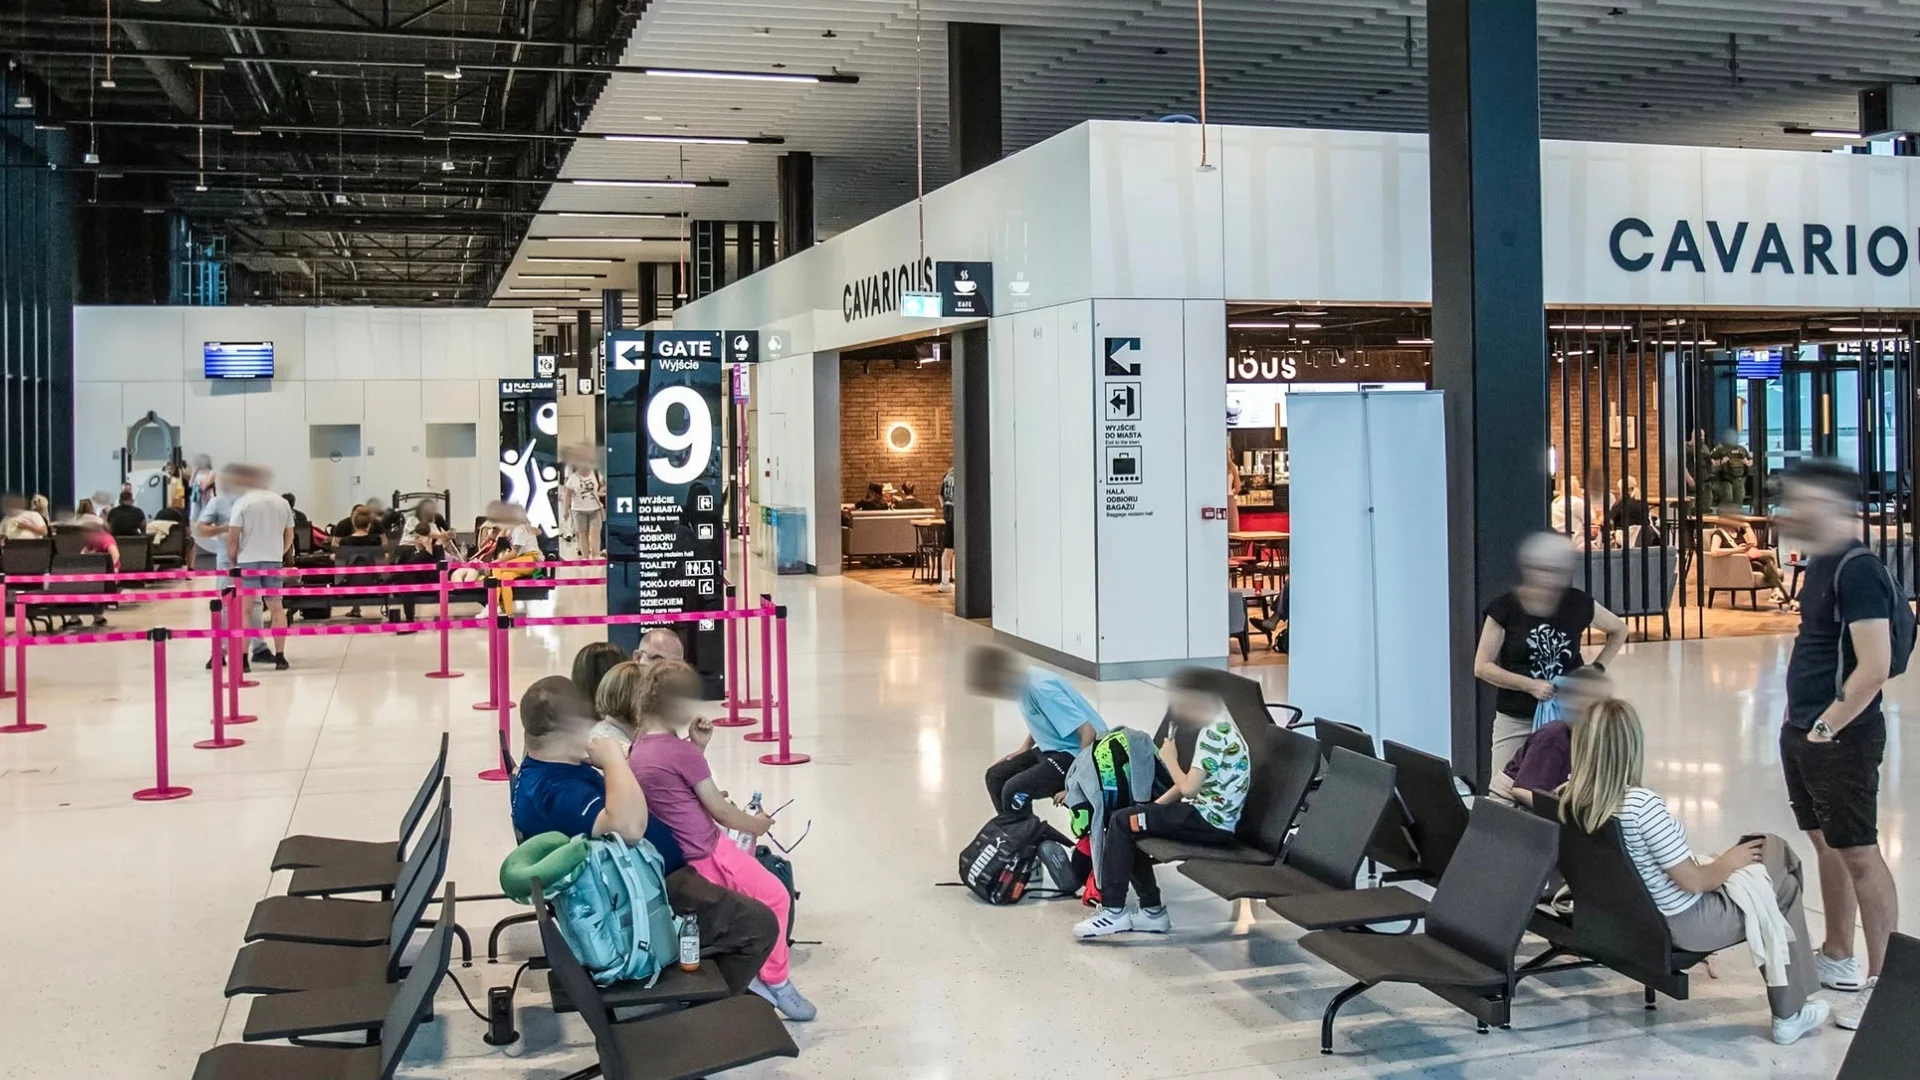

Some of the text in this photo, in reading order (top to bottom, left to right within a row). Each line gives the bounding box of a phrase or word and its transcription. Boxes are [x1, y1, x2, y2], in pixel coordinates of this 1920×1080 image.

[1608, 217, 1920, 277] CAVARIO
[843, 256, 933, 323] CAVARIOUS
[659, 340, 711, 357] GATE
[659, 359, 700, 373] Wyjście
[646, 385, 713, 485] 9
[639, 495, 675, 504] WYJŚCIE
[652, 505, 683, 513] MIASTA
[640, 534, 676, 542] ODBIORU
[640, 542, 673, 551] BAGAŻU
[640, 579, 696, 588] POKÓJ OPIEKI
[640, 589, 658, 597] NAD
[640, 598, 683, 606] DZIECKIEM
[968, 844, 998, 886] PUMA
